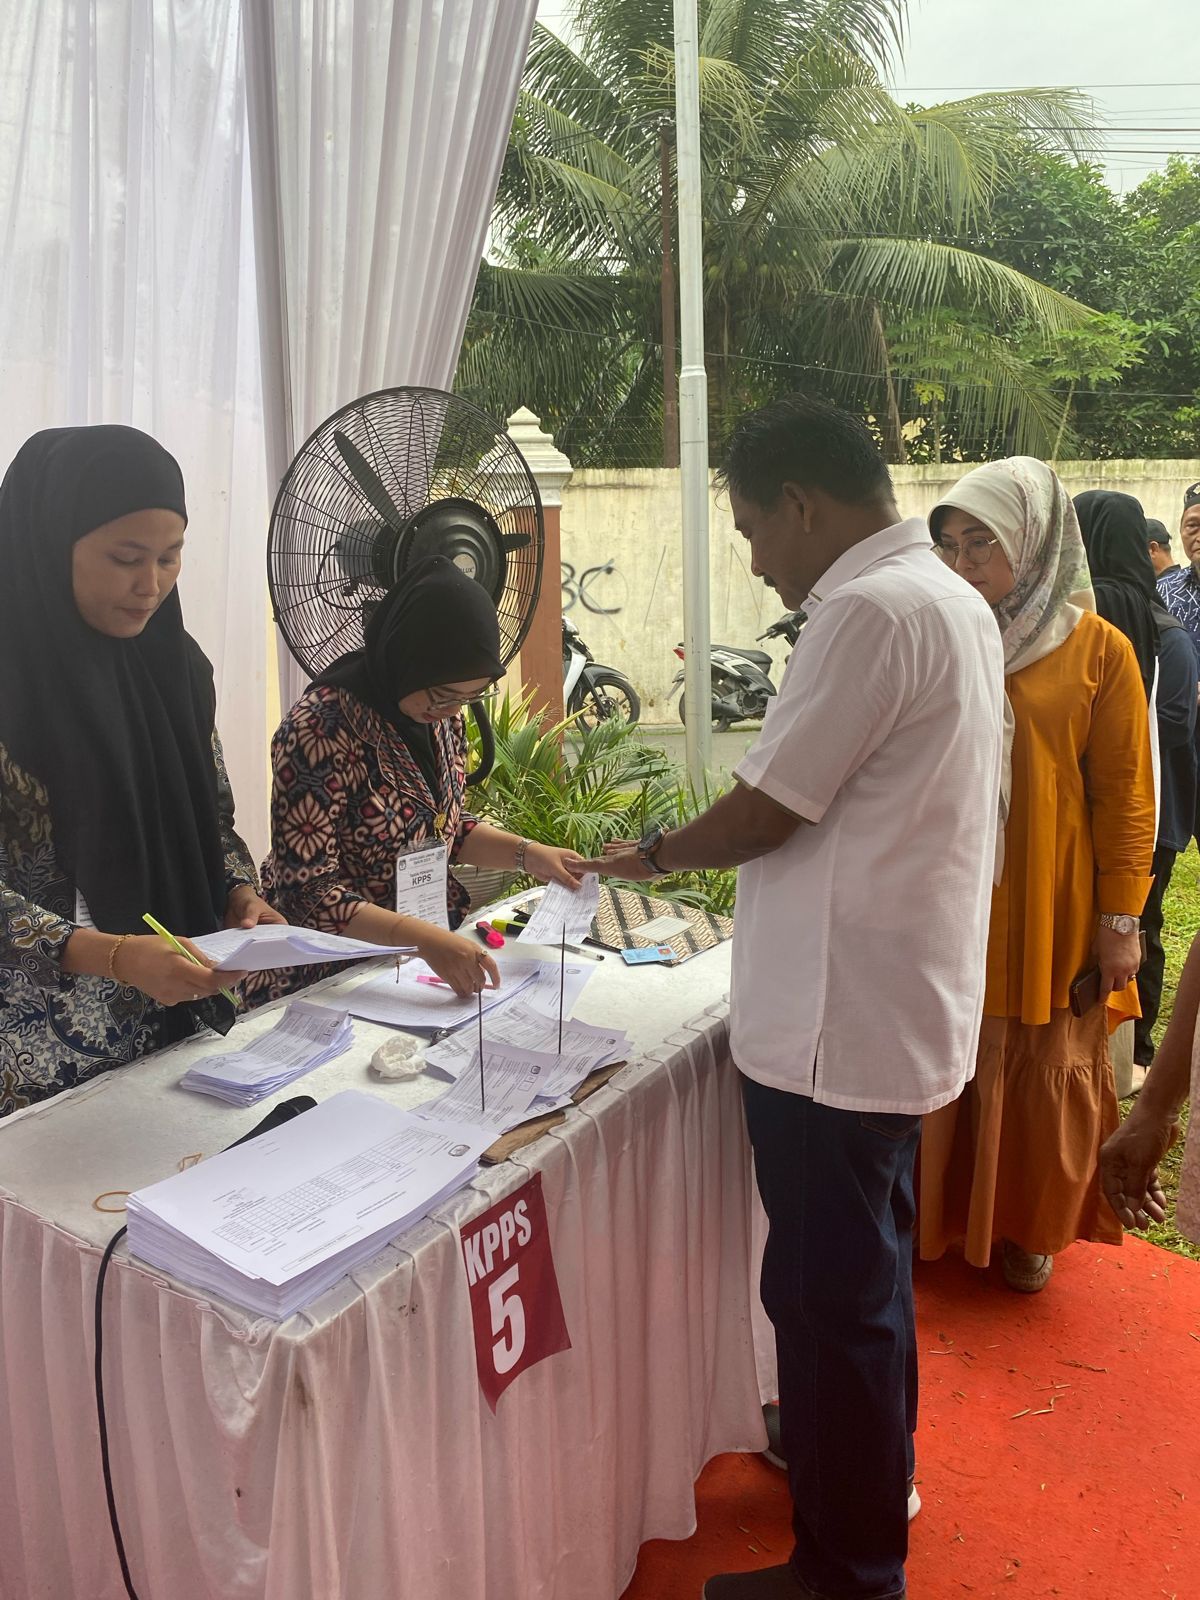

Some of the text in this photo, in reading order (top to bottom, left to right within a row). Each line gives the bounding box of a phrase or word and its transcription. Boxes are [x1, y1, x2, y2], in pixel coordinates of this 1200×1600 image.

[412, 873, 432, 886] KPPS
[464, 1199, 532, 1287] KPPS
[488, 1262, 526, 1375] 5
